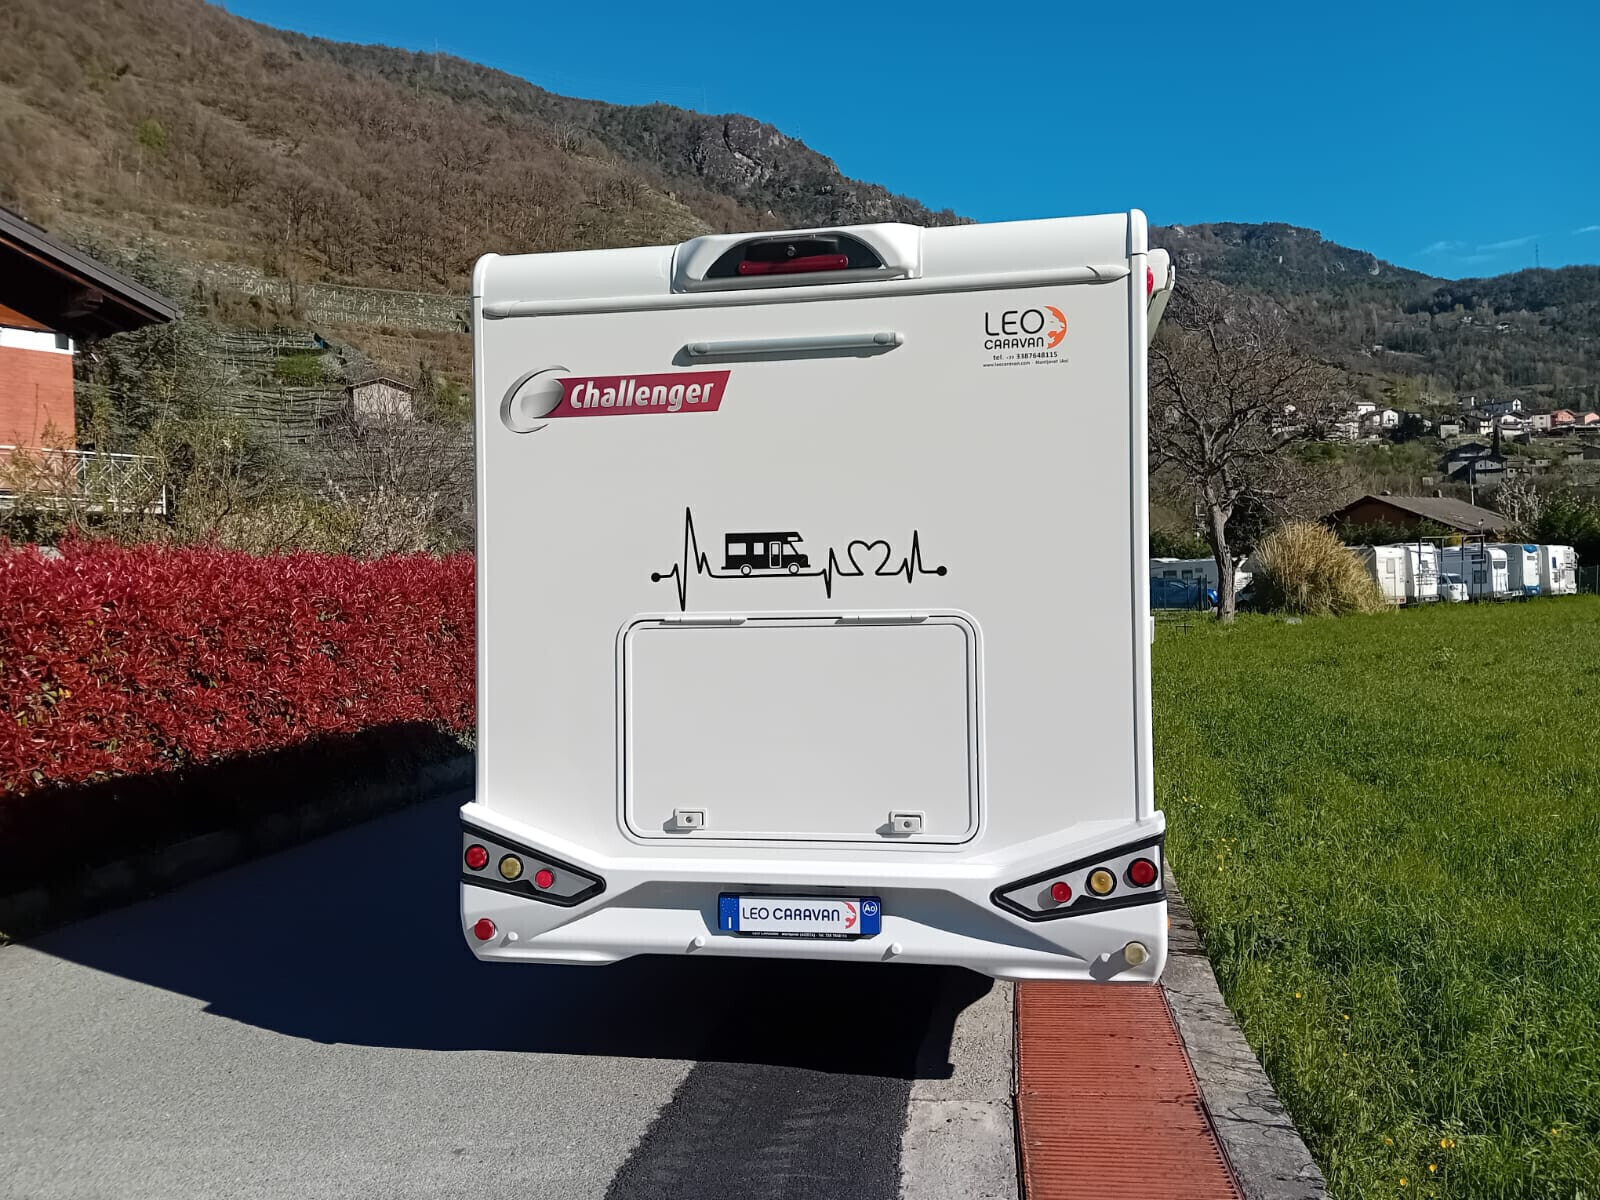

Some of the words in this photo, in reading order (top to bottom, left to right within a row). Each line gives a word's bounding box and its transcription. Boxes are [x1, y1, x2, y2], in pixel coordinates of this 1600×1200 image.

[985, 309, 1044, 336] LEO
[984, 337, 1044, 350] CARAVAN
[570, 378, 714, 412] Challenger
[742, 907, 769, 920] LEO
[773, 908, 840, 922] CARAVAN
